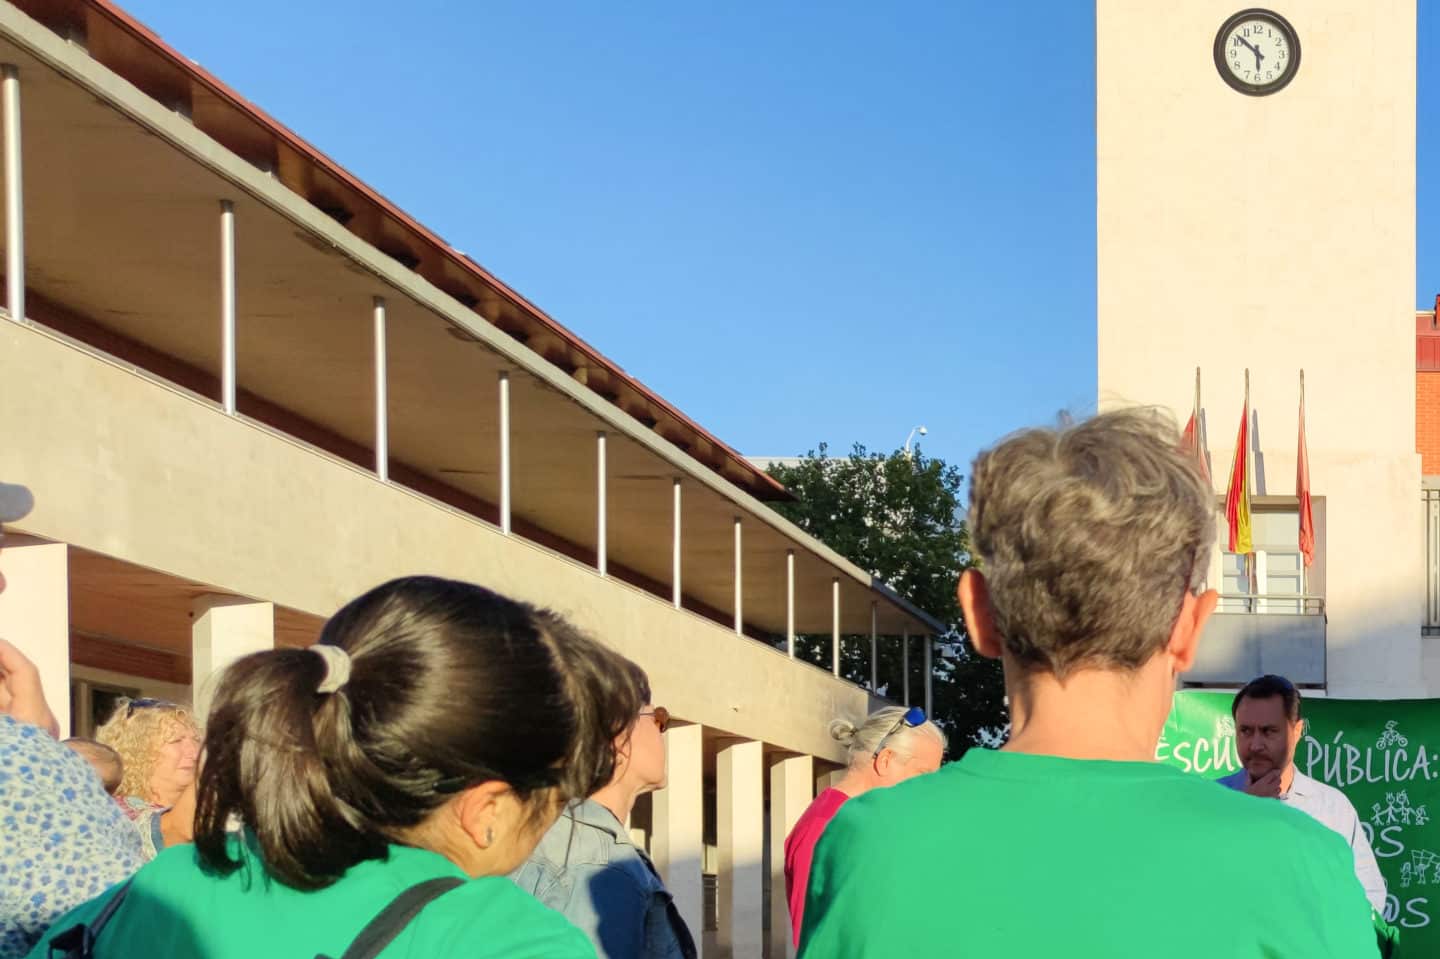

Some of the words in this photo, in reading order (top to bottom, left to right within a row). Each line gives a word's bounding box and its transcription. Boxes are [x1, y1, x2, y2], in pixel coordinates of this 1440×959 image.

[1243, 28, 1250, 37] 11
[1253, 25, 1263, 34] 12
[1154, 735, 1244, 773] ESCU
[1305, 731, 1438, 787] PÚBLICA:
